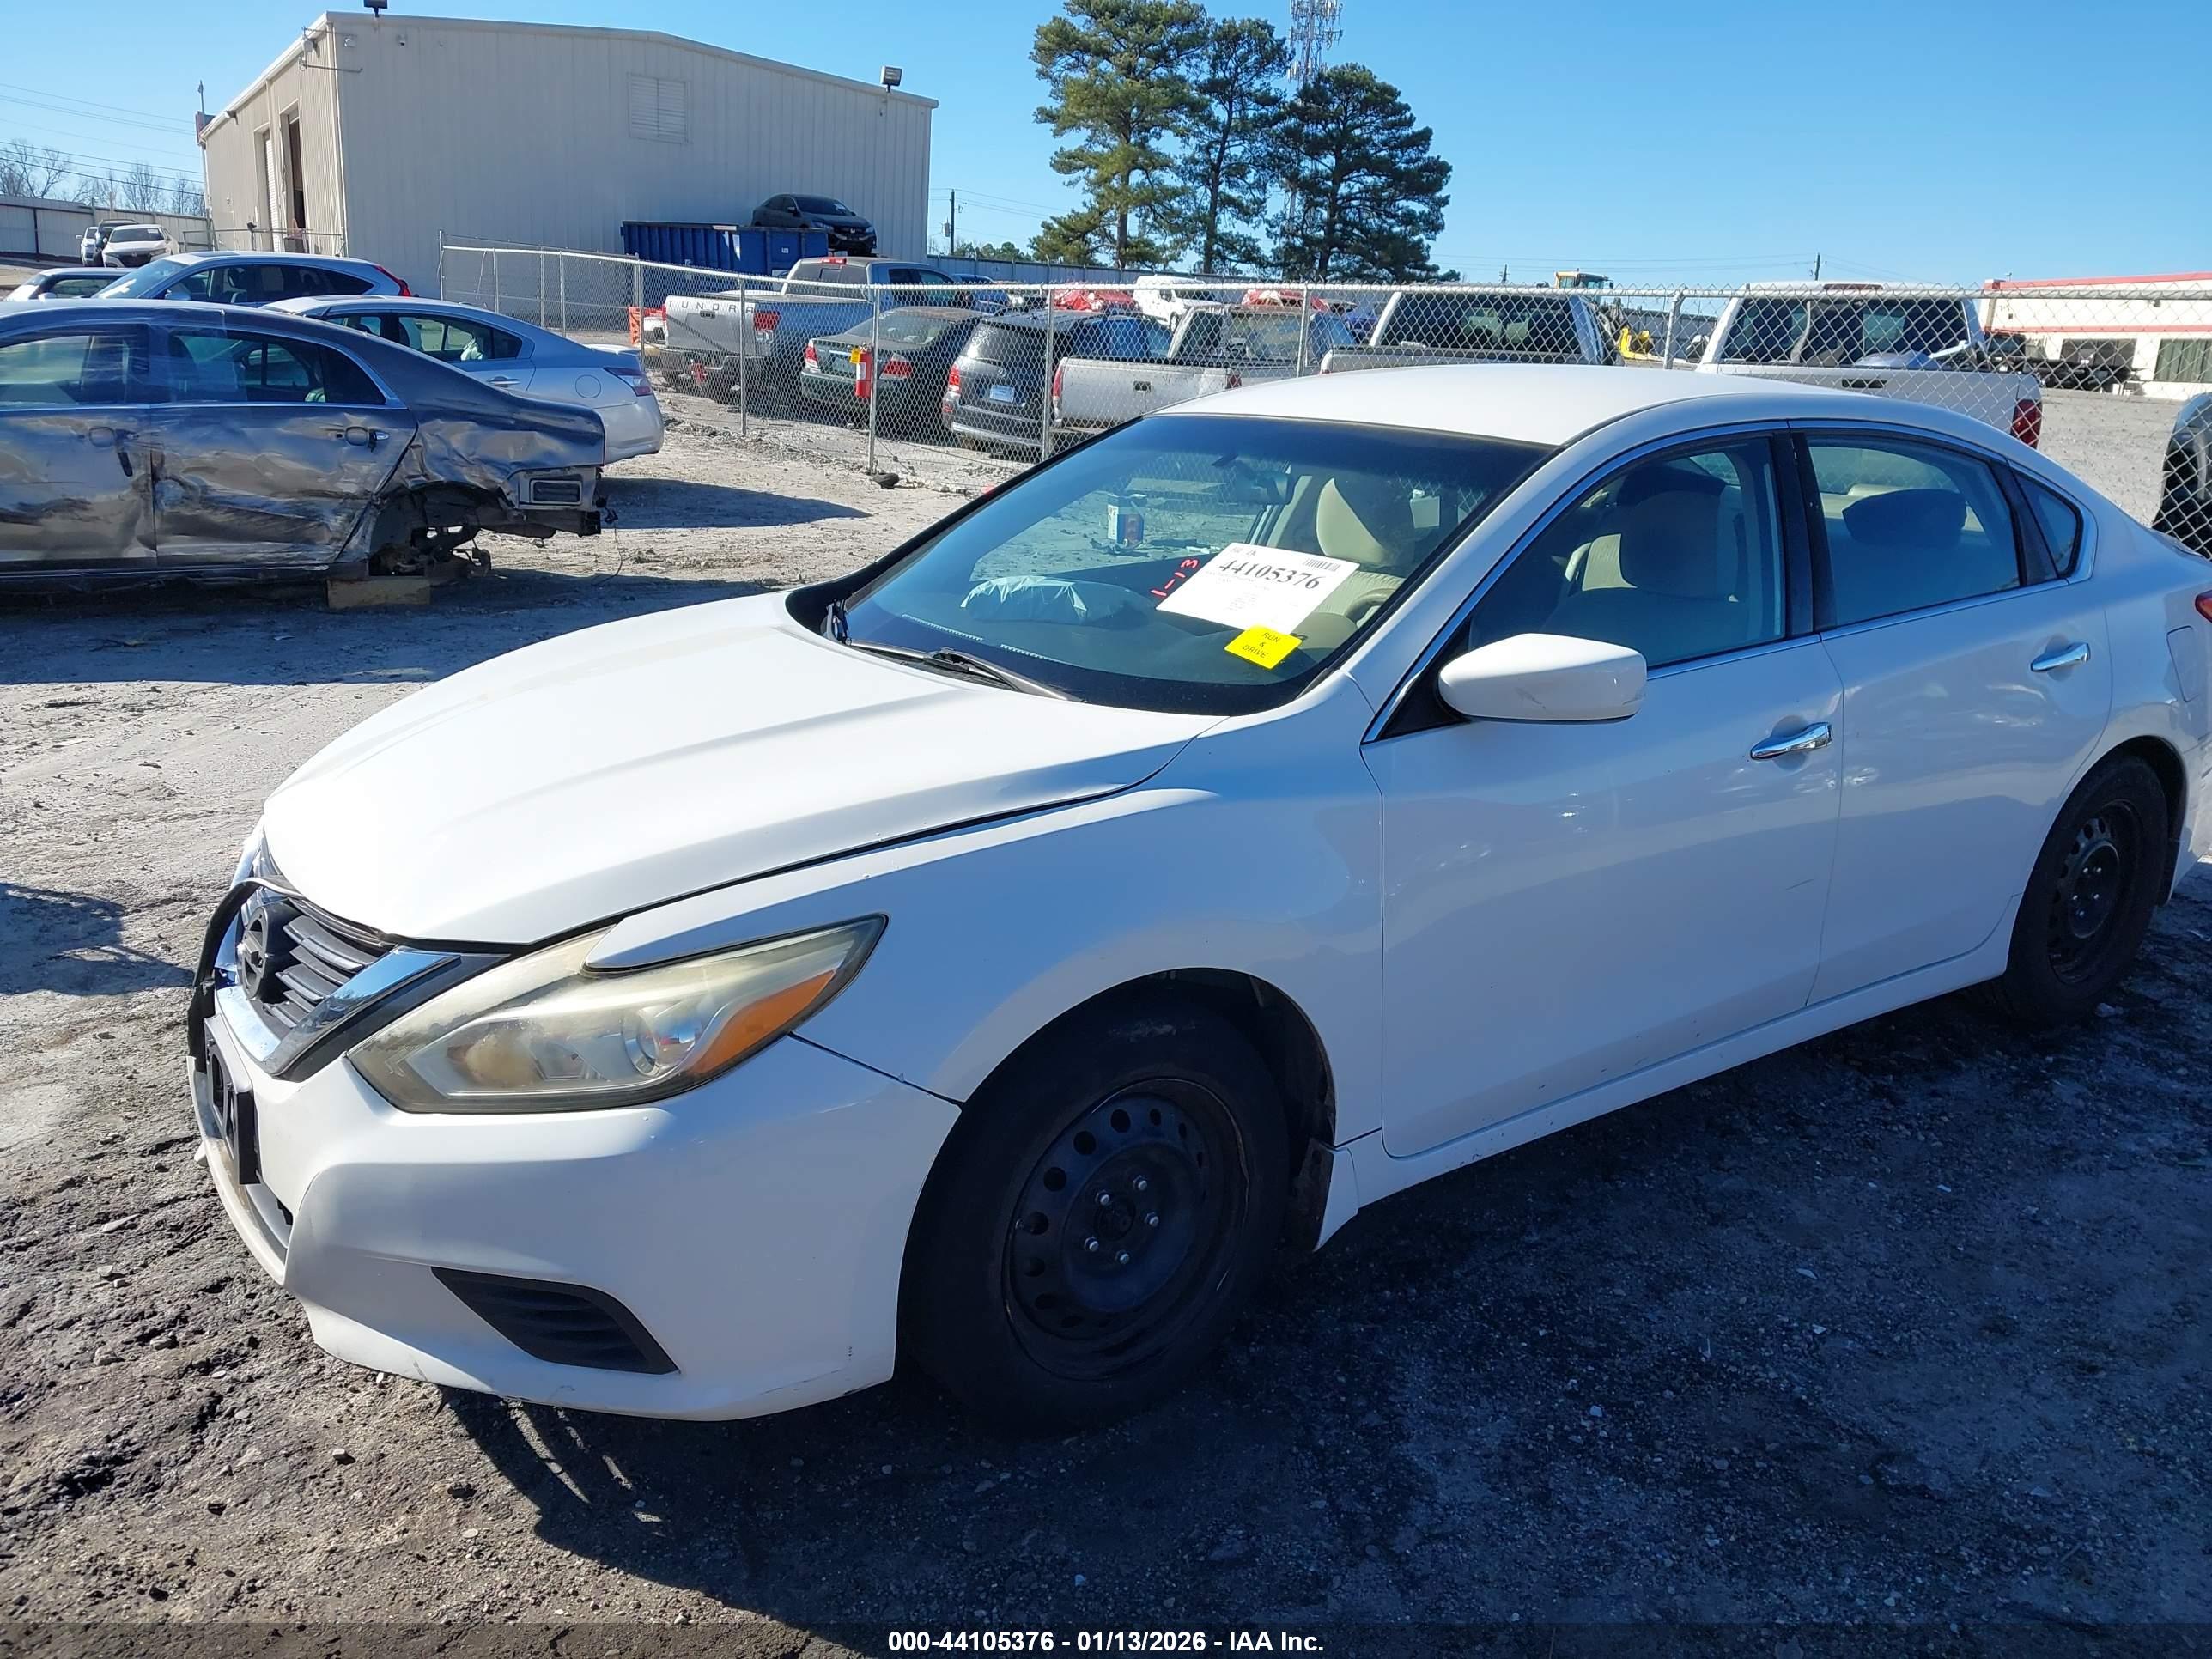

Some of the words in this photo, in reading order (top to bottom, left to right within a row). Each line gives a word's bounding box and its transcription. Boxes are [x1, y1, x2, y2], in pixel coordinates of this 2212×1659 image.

[668, 301, 754, 314] TUNDRA
[1218, 559, 1325, 590] 44105376
[1261, 632, 1281, 643] RUN
[1242, 644, 1269, 659] DRIVE
